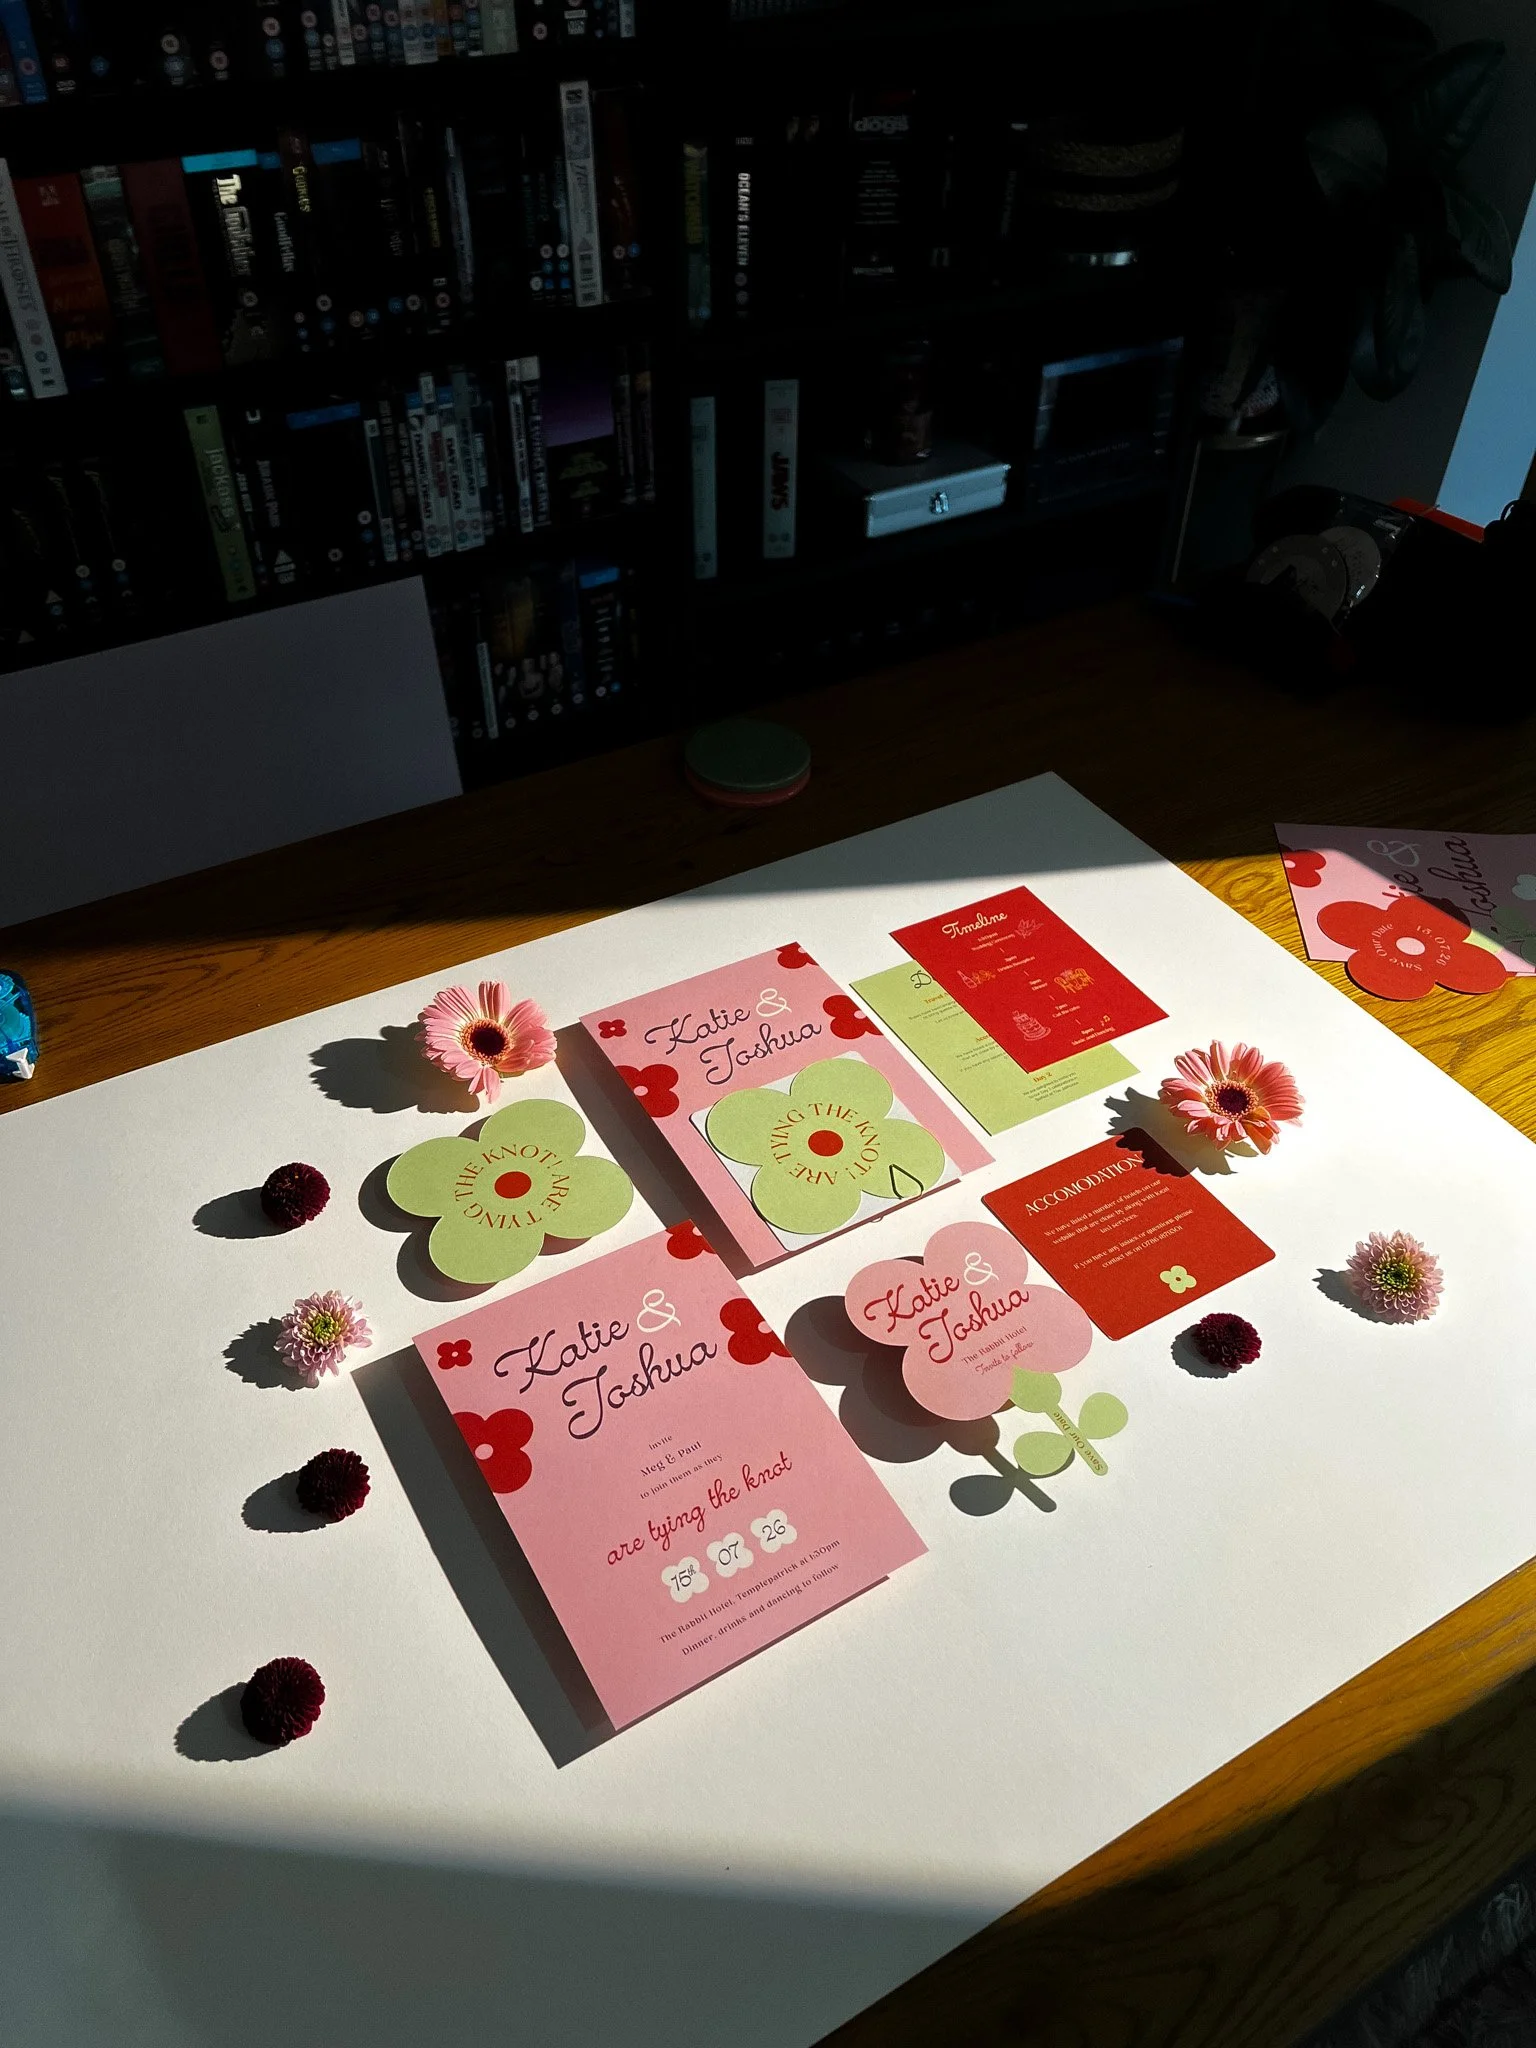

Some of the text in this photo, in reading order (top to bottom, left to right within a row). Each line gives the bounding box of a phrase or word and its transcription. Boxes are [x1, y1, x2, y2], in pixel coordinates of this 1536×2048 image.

[215, 173, 242, 205] The
[736, 172, 751, 266] OCEAN'S ELEVEN
[771, 451, 789, 510] JAWS
[941, 912, 1008, 939] Timeline
[1371, 923, 1423, 972] Save Our Date
[643, 988, 792, 1055] Katie &
[699, 1022, 822, 1085] Joshua
[770, 1108, 806, 1164] TYING
[808, 1102, 857, 1125] THE
[455, 1162, 484, 1202] THE
[540, 1172, 571, 1213] ARE
[788, 1162, 838, 1186] ARE
[1024, 1153, 1144, 1217] ACCOMODATION
[463, 1202, 543, 1230] TYING
[864, 1251, 999, 1333] Katie &
[493, 1288, 682, 1394] Katie &
[918, 1289, 1030, 1364] Joshua
[961, 1326, 1028, 1366] The Rabbit Hotel
[561, 1341, 718, 1440] Joshua
[639, 1441, 702, 1478] Meg & Paul
[648, 1434, 673, 1451] invite
[1053, 1411, 1102, 1472] Save Our Date
[640, 1452, 724, 1500] to join them as they
[607, 1450, 792, 1566] are tying the knot
[762, 1518, 787, 1542] 26
[717, 1540, 740, 1566] 07
[659, 1630, 677, 1644] The
[677, 1612, 708, 1634] Rabbit
[736, 1562, 799, 1602] Templepatrick
[799, 1556, 808, 1566] at
[671, 1564, 697, 1592] 15th
[718, 1614, 747, 1635] drinks
[749, 1603, 766, 1618] and
[766, 1584, 802, 1610] dancing
[802, 1577, 811, 1588] to
[812, 1562, 841, 1582] follow
